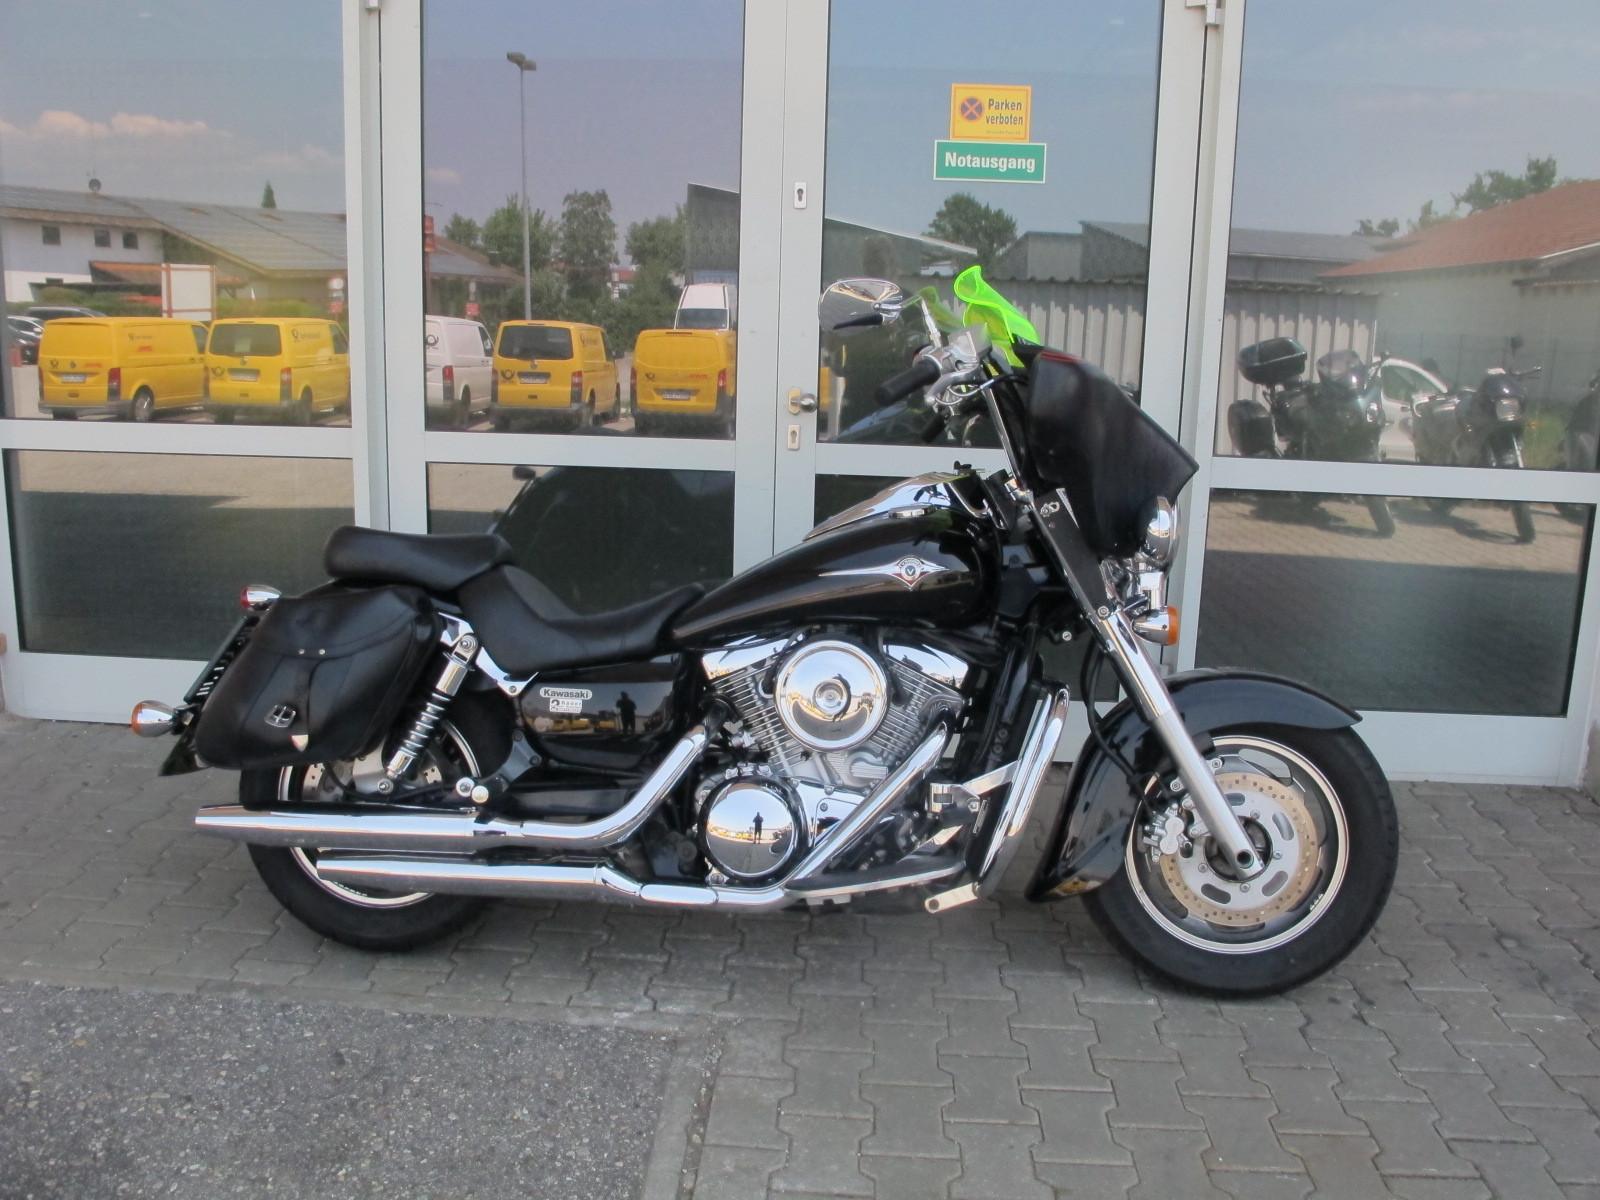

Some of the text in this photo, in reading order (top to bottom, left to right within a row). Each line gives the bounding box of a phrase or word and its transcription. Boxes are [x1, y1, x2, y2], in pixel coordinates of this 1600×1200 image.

[988, 98, 1022, 111] Parken
[985, 113, 1023, 125] verboten
[944, 151, 1036, 173] Notausgang
[543, 688, 589, 699] Kawasaki
